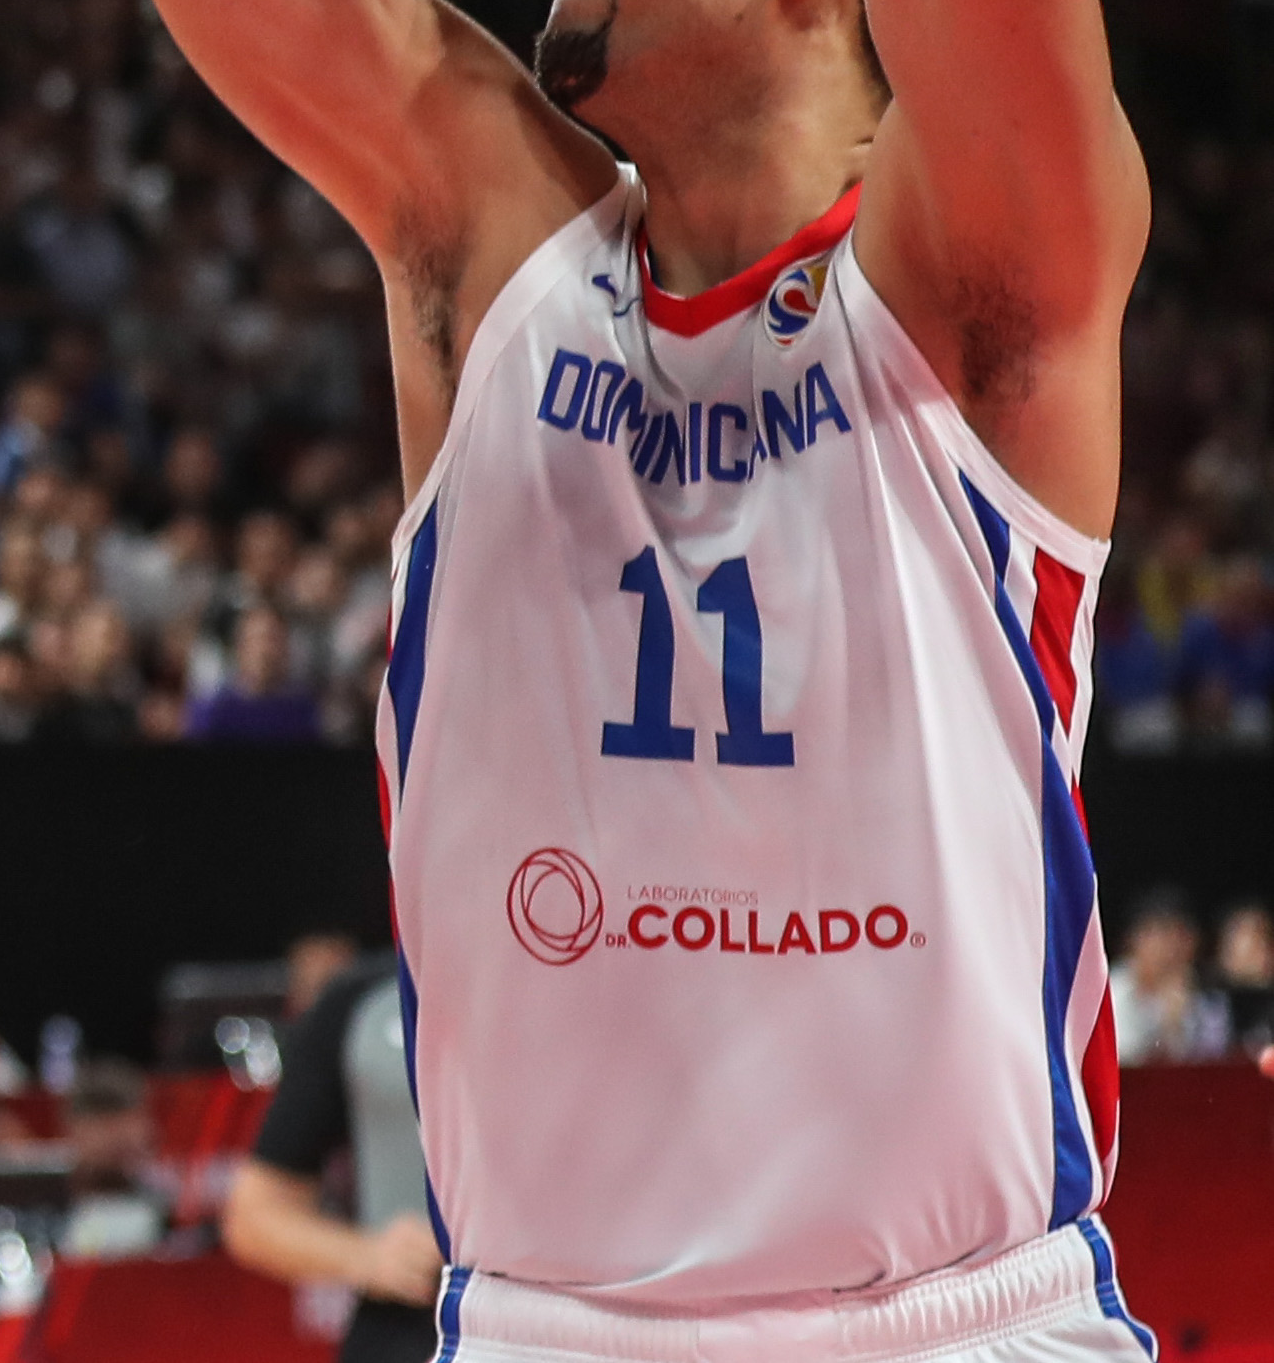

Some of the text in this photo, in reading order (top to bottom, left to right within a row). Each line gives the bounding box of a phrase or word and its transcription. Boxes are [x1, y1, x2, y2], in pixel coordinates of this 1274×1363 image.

[600, 544, 796, 768] 11
[626, 885, 760, 907] LABORATORIOS
[627, 903, 910, 956] COLLADO
